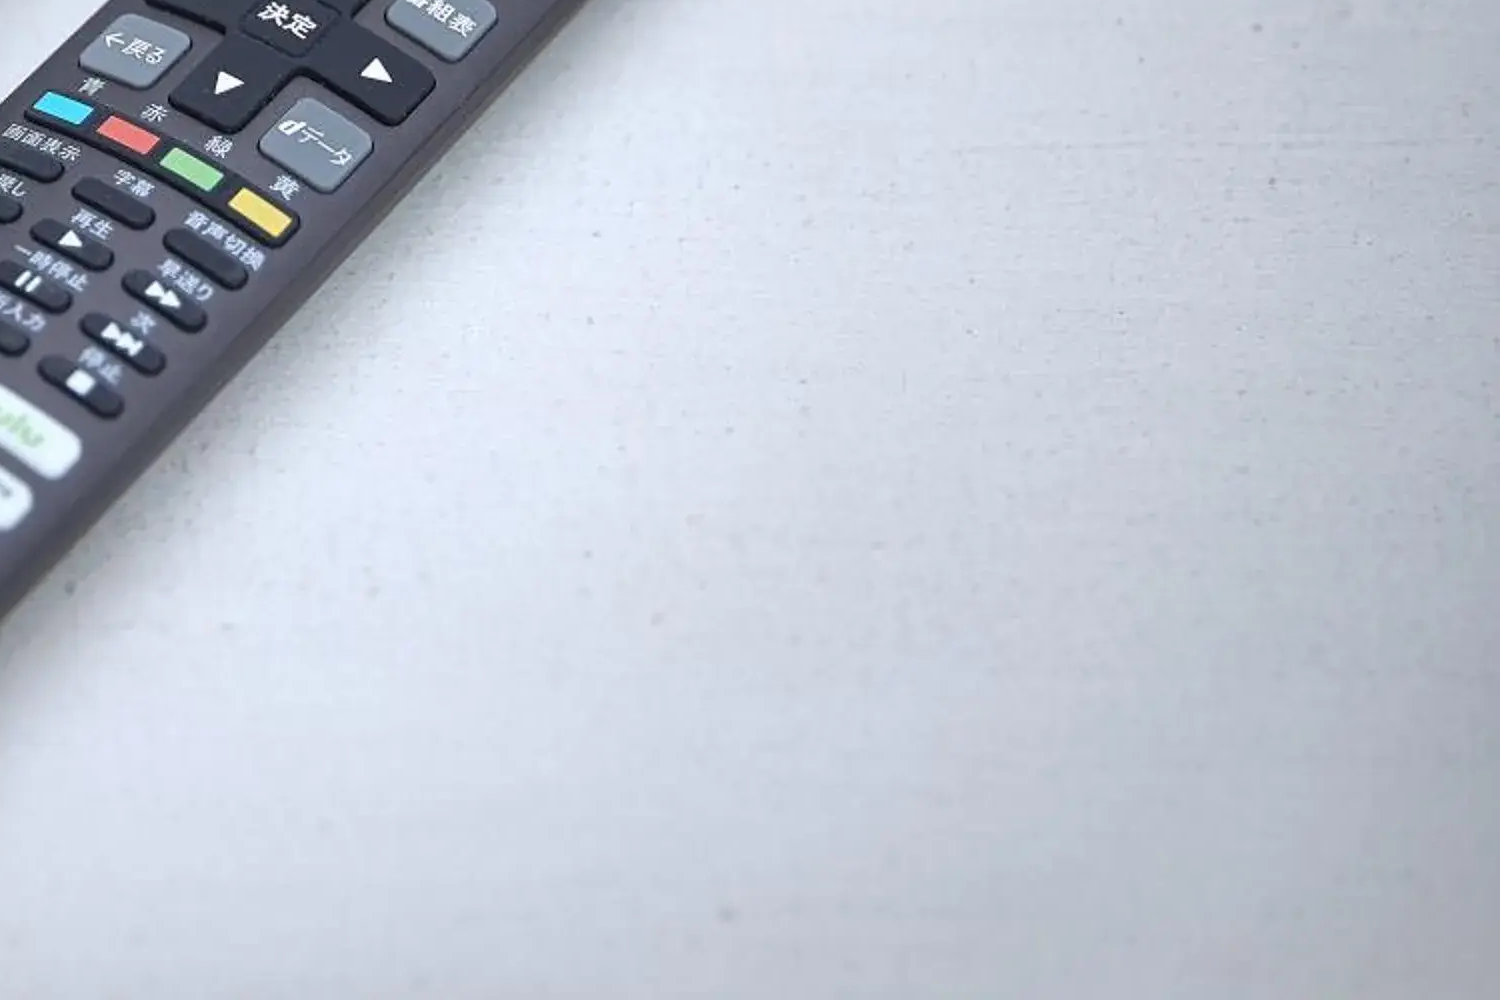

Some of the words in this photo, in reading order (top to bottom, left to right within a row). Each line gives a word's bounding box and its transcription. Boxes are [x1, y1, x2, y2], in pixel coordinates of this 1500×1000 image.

[256, 1, 317, 39] 決定
[122, 38, 167, 65] 戻る
[78, 76, 107, 97] 青
[140, 104, 169, 123] 赤
[2, 123, 82, 162] 画面表示
[204, 135, 234, 158] 緑
[113, 169, 156, 197] 字幕
[268, 173, 300, 200] 黄
[71, 208, 115, 240] 再生
[184, 210, 267, 271] 音声切換
[13, 244, 89, 291] 一時停止
[157, 257, 214, 301] 早送り
[130, 311, 156, 334] 次
[78, 346, 124, 385] 停止
